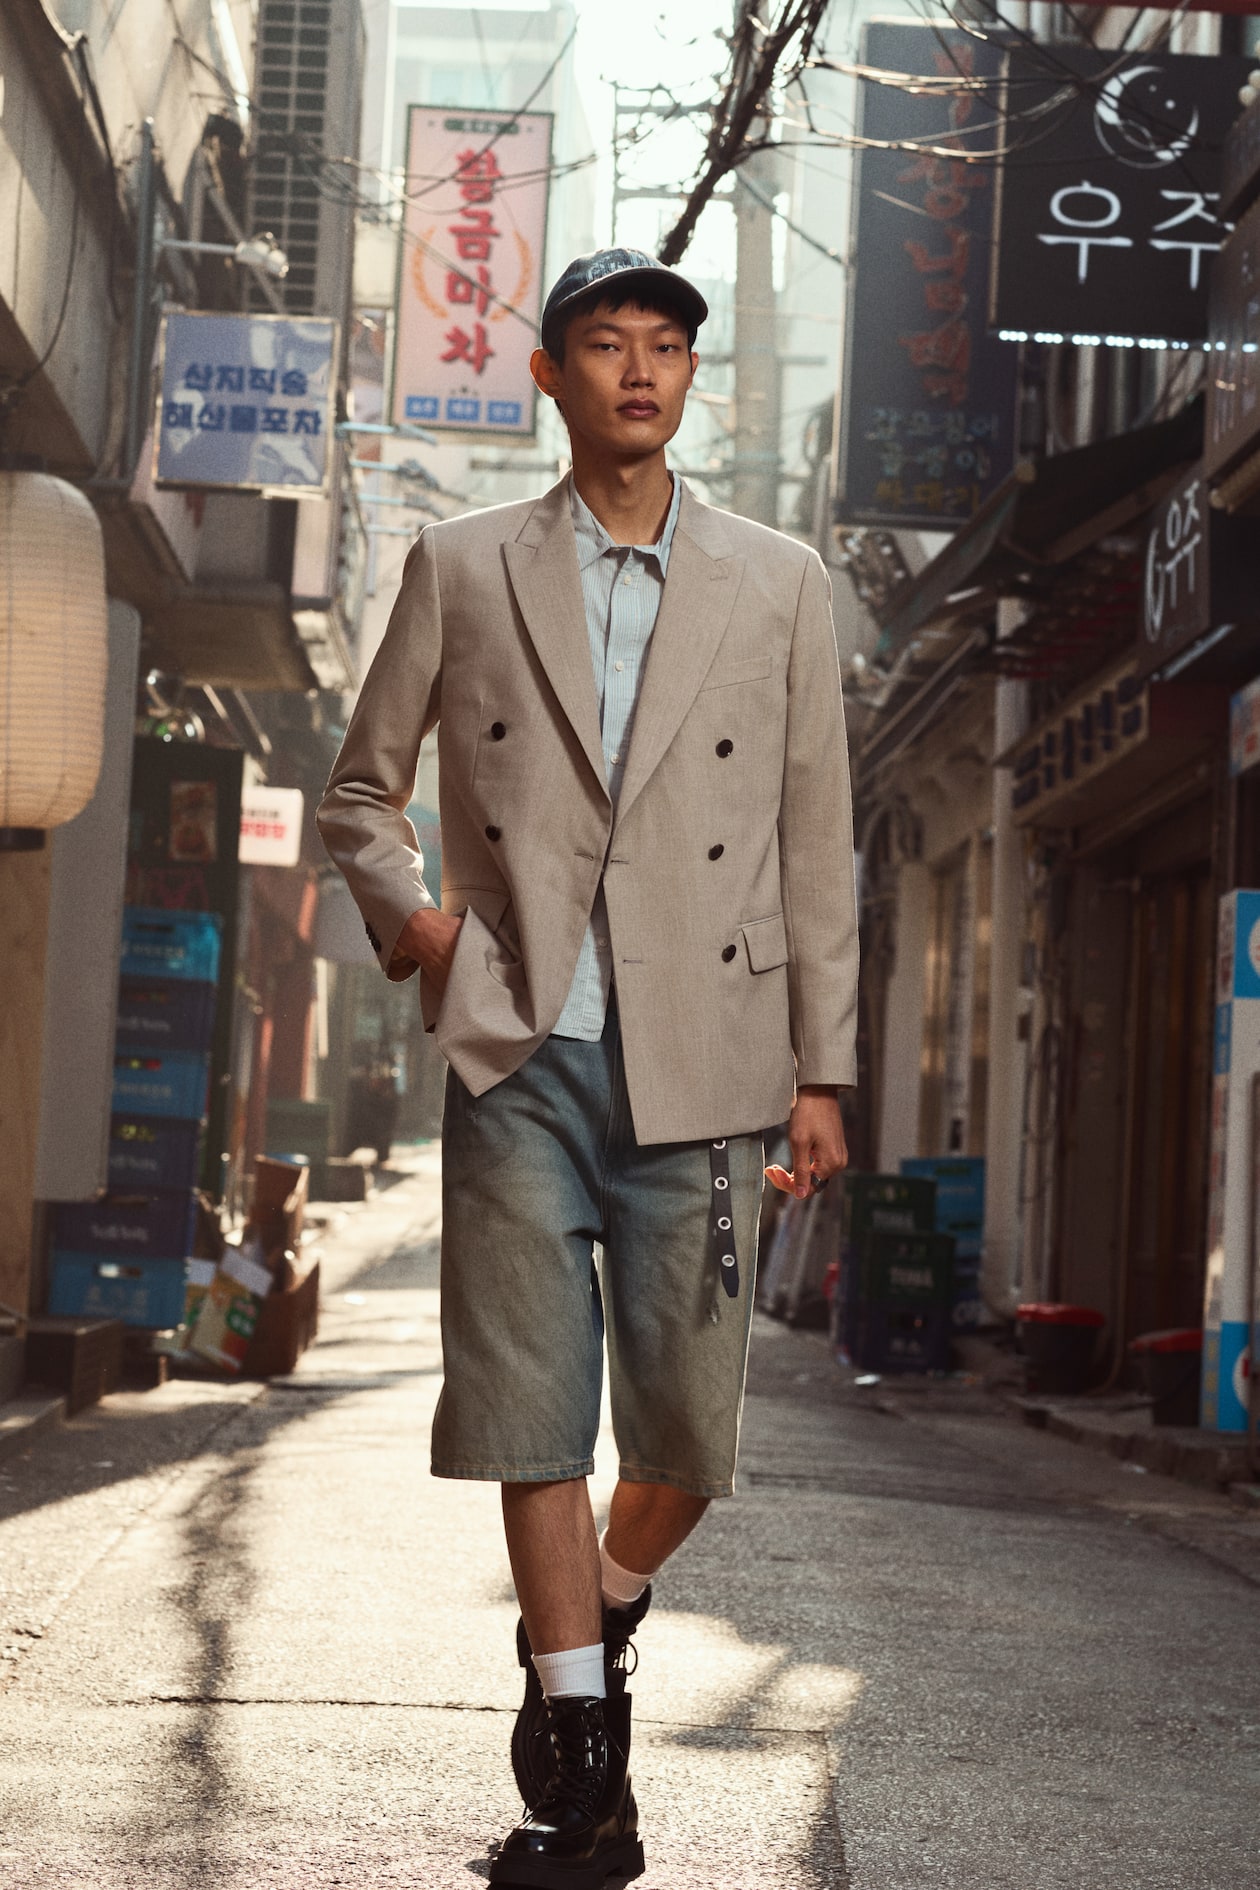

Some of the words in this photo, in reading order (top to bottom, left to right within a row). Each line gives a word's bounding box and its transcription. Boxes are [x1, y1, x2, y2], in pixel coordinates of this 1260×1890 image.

[439, 148, 502, 375] 황금마차
[1036, 180, 1236, 290] 우주
[184, 363, 308, 396] 산지직송
[164, 400, 322, 436] 해산물포차
